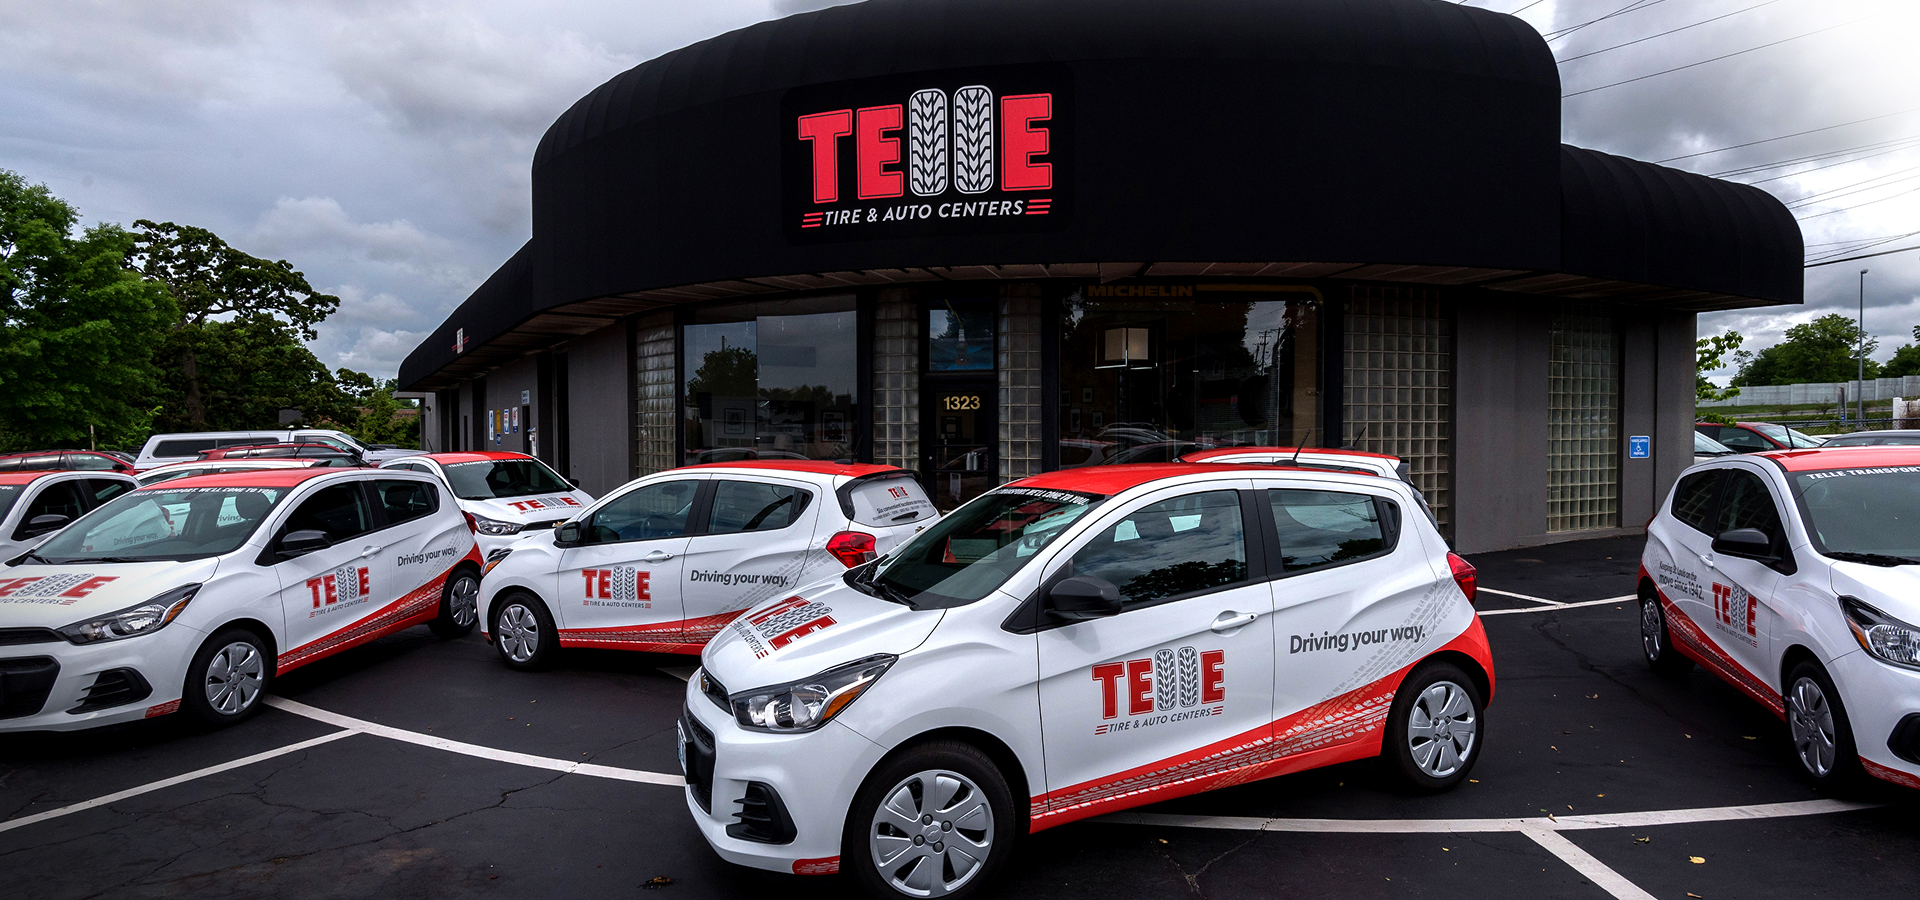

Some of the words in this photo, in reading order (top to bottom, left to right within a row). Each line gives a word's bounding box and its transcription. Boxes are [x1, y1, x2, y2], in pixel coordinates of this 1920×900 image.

[825, 209, 860, 225] TIRE
[866, 207, 877, 222] &
[883, 204, 931, 222] AUTO
[938, 200, 1024, 218] CENTERS
[1088, 285, 1193, 297] MICHELIN
[943, 395, 980, 410] 1323
[1806, 471, 1847, 480] TELLE
[113, 536, 133, 546] Driving
[397, 553, 424, 567] Driving
[424, 550, 441, 563] your
[441, 546, 458, 557] way.
[690, 569, 732, 586] Driving
[733, 573, 760, 586] your
[762, 574, 789, 588] way.
[1659, 573, 1674, 588] move
[1290, 630, 1349, 655] Driving
[1351, 628, 1388, 651] your
[1390, 624, 1426, 644] way.
[1109, 720, 1131, 733] TIRE
[1133, 718, 1140, 729] &
[1141, 714, 1169, 728] AUTO
[1170, 707, 1212, 723] CENTERS
